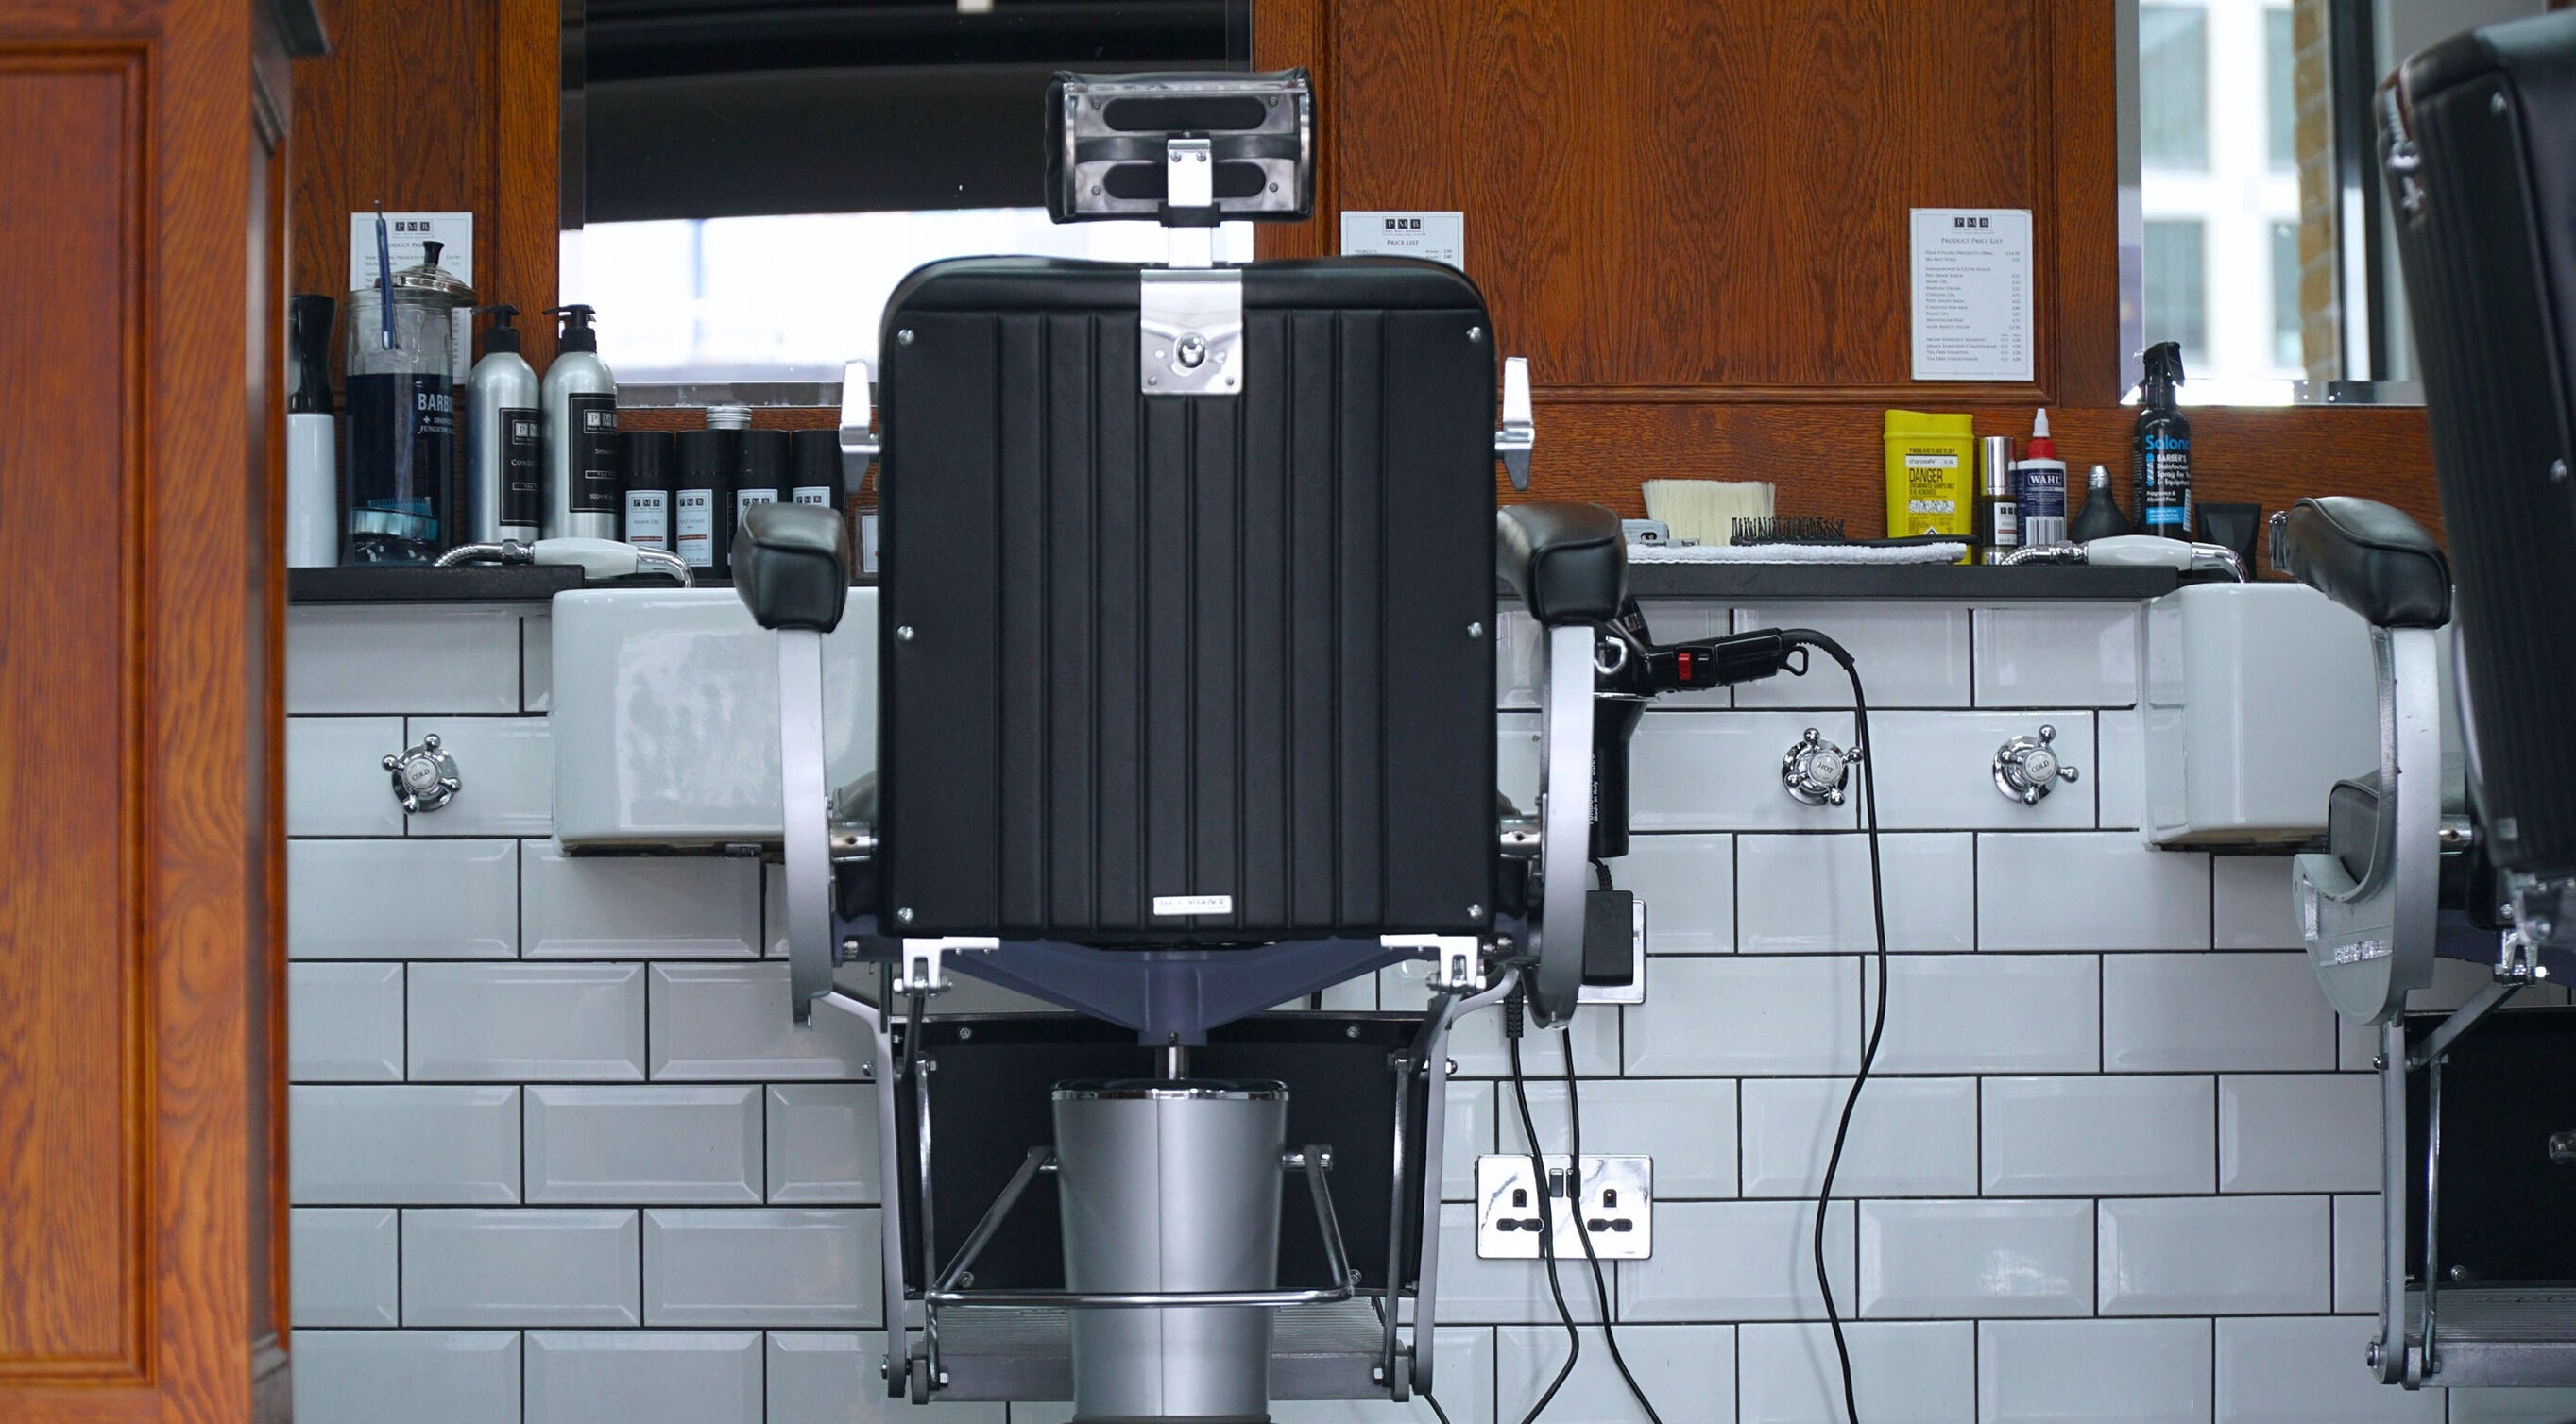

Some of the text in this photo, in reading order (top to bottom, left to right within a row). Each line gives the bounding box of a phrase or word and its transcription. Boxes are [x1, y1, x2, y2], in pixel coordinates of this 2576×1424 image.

[1909, 468, 1943, 483] DANGER
[2030, 475, 2061, 484] WAHL
[1817, 762, 1834, 773] HOT
[2031, 759, 2050, 772] COLD
[412, 769, 430, 781] COLD
